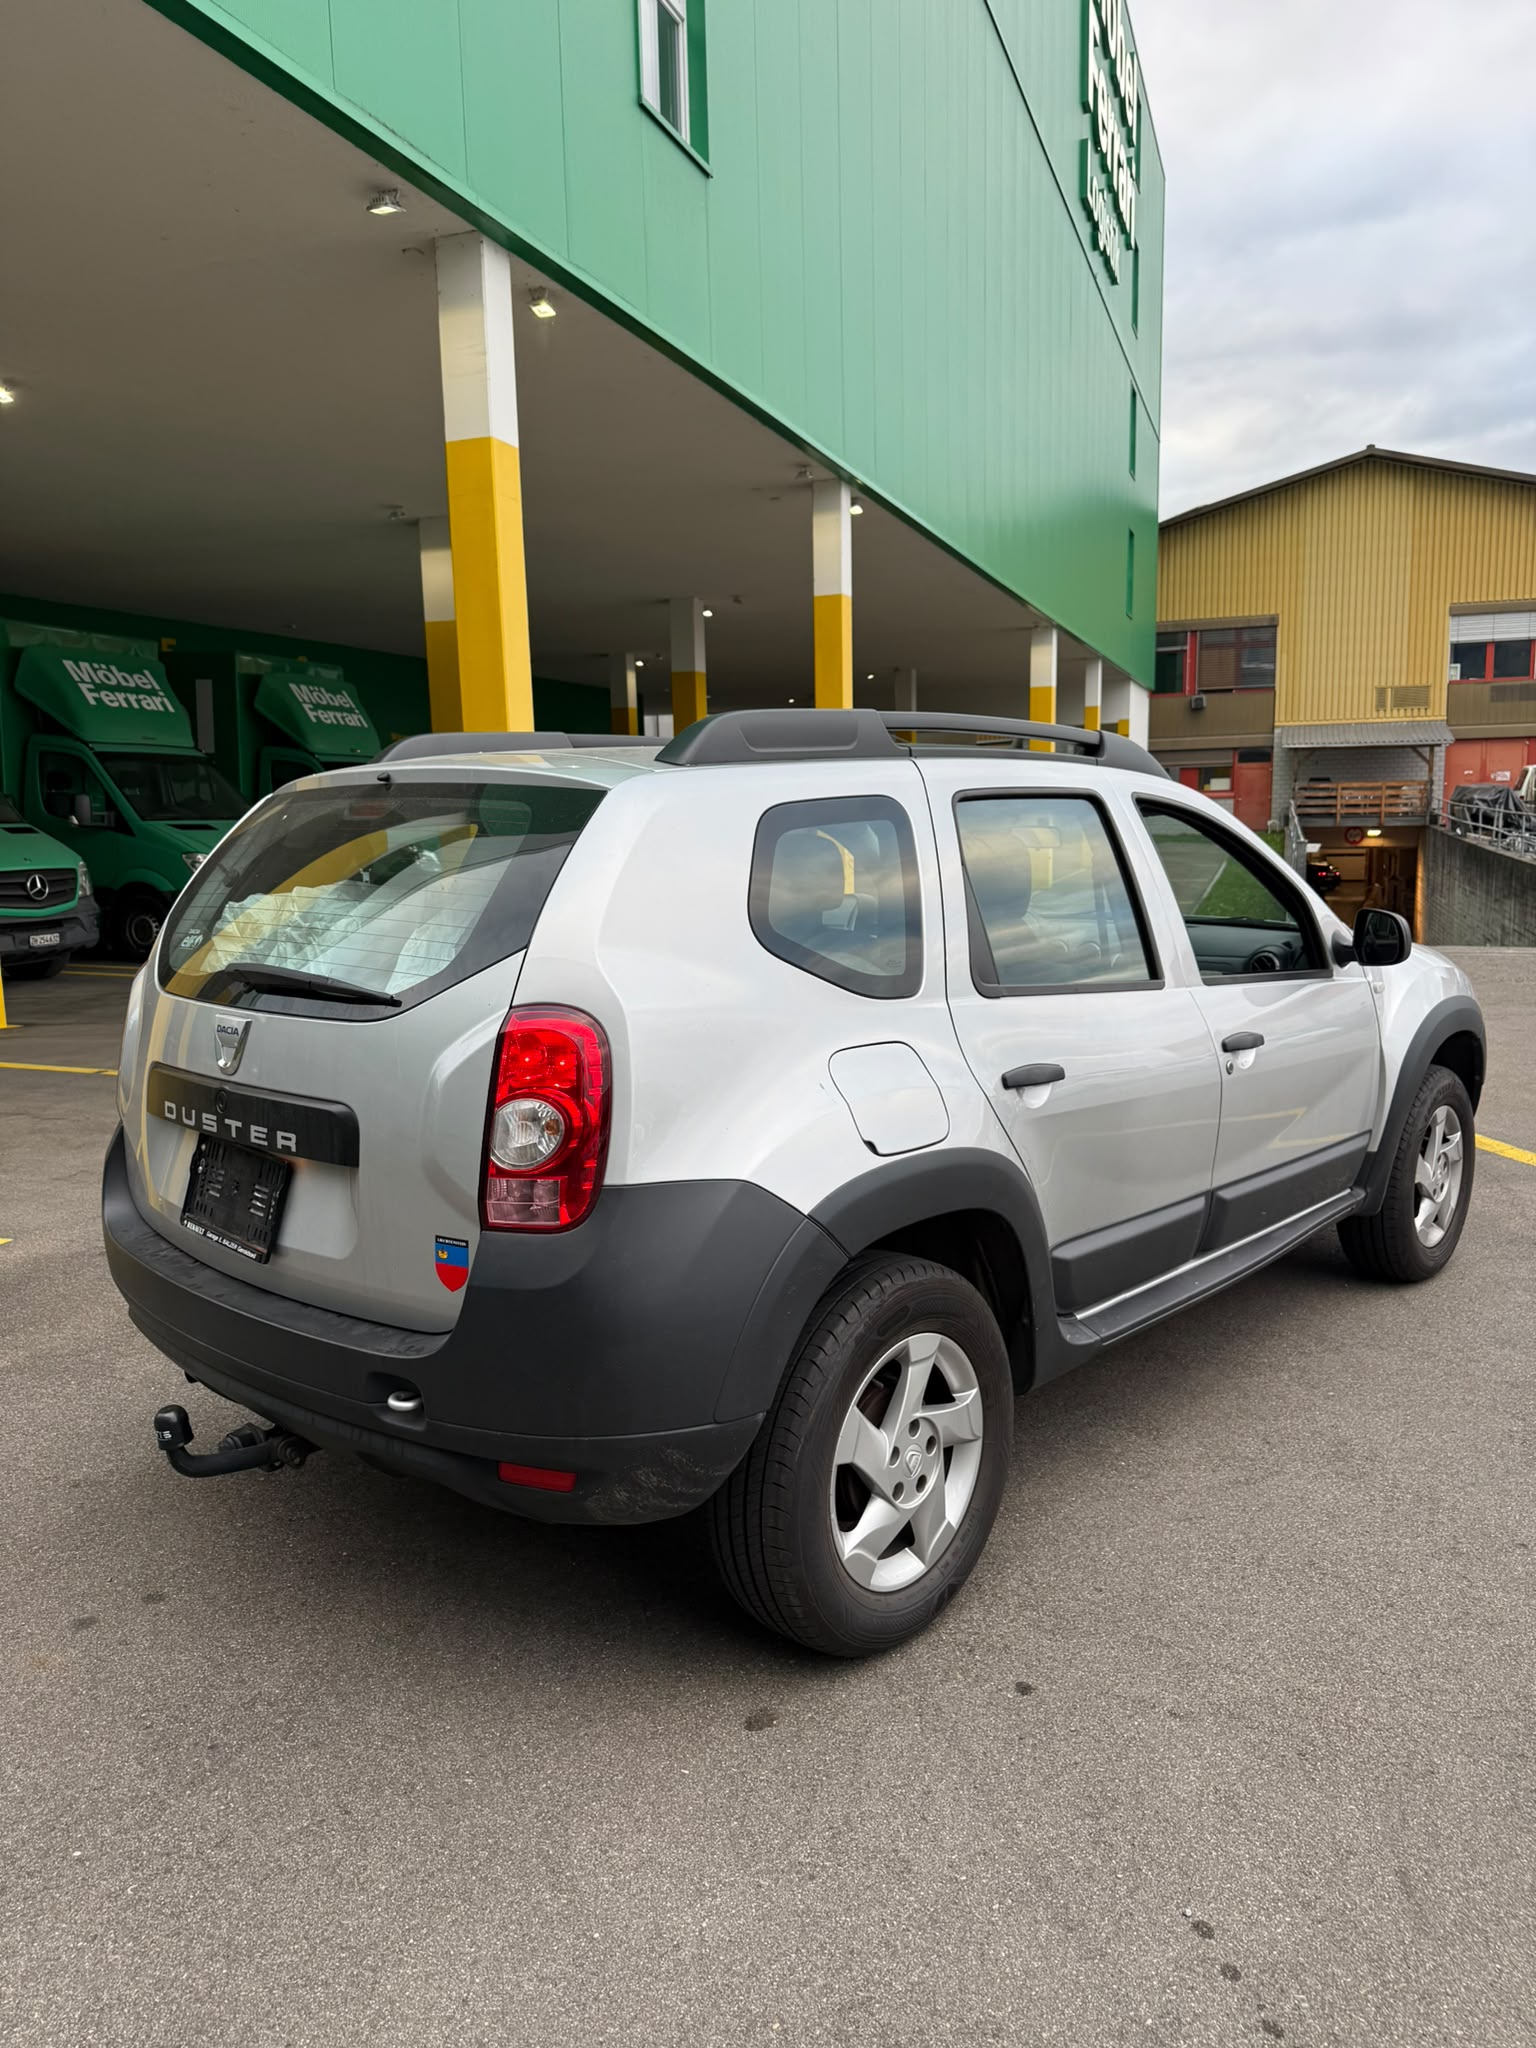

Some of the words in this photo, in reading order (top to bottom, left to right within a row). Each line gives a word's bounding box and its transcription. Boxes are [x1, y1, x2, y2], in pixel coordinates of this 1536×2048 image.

[1088, 0, 1136, 250] Ferrari
[62, 659, 161, 690] Möbel
[78, 682, 175, 713] Ferrari
[288, 682, 356, 708] Möbel
[302, 703, 368, 728] Ferrari
[216, 1024, 240, 1036] DACIA
[164, 1100, 297, 1152] DUSTER
